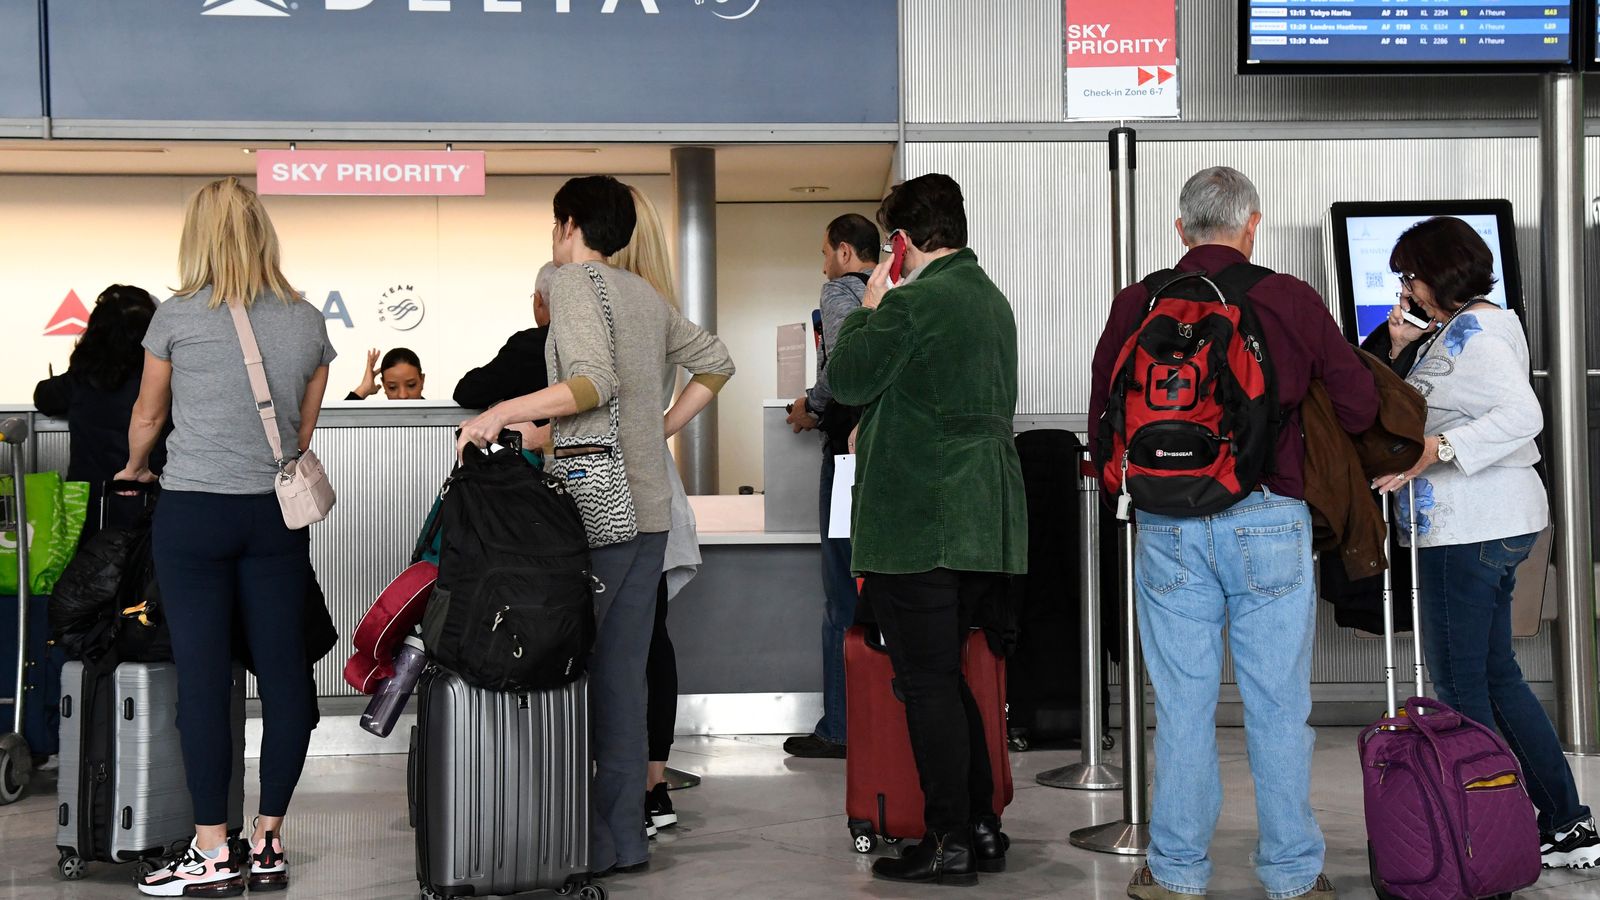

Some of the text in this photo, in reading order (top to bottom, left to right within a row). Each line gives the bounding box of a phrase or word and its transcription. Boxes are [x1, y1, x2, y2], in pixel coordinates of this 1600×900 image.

[1310, 9, 1330, 18] Tokyo
[1331, 9, 1352, 17] Narita
[1381, 9, 1391, 17] AF
[1395, 9, 1408, 17] 276
[1420, 9, 1428, 17] KL
[1068, 24, 1111, 39] SKY
[1310, 23, 1336, 31] Londres
[1336, 23, 1368, 31] Heathrow
[1381, 23, 1390, 31] AF
[1068, 38, 1168, 55] PRIORITY
[1309, 37, 1329, 45] Dubai
[1381, 37, 1390, 45] AF
[1419, 37, 1428, 45] KL
[1083, 87, 1164, 97] Check-in Zone 6-7
[272, 163, 465, 183] SKY PRIORITY
[378, 284, 414, 322] SKYTEAM
